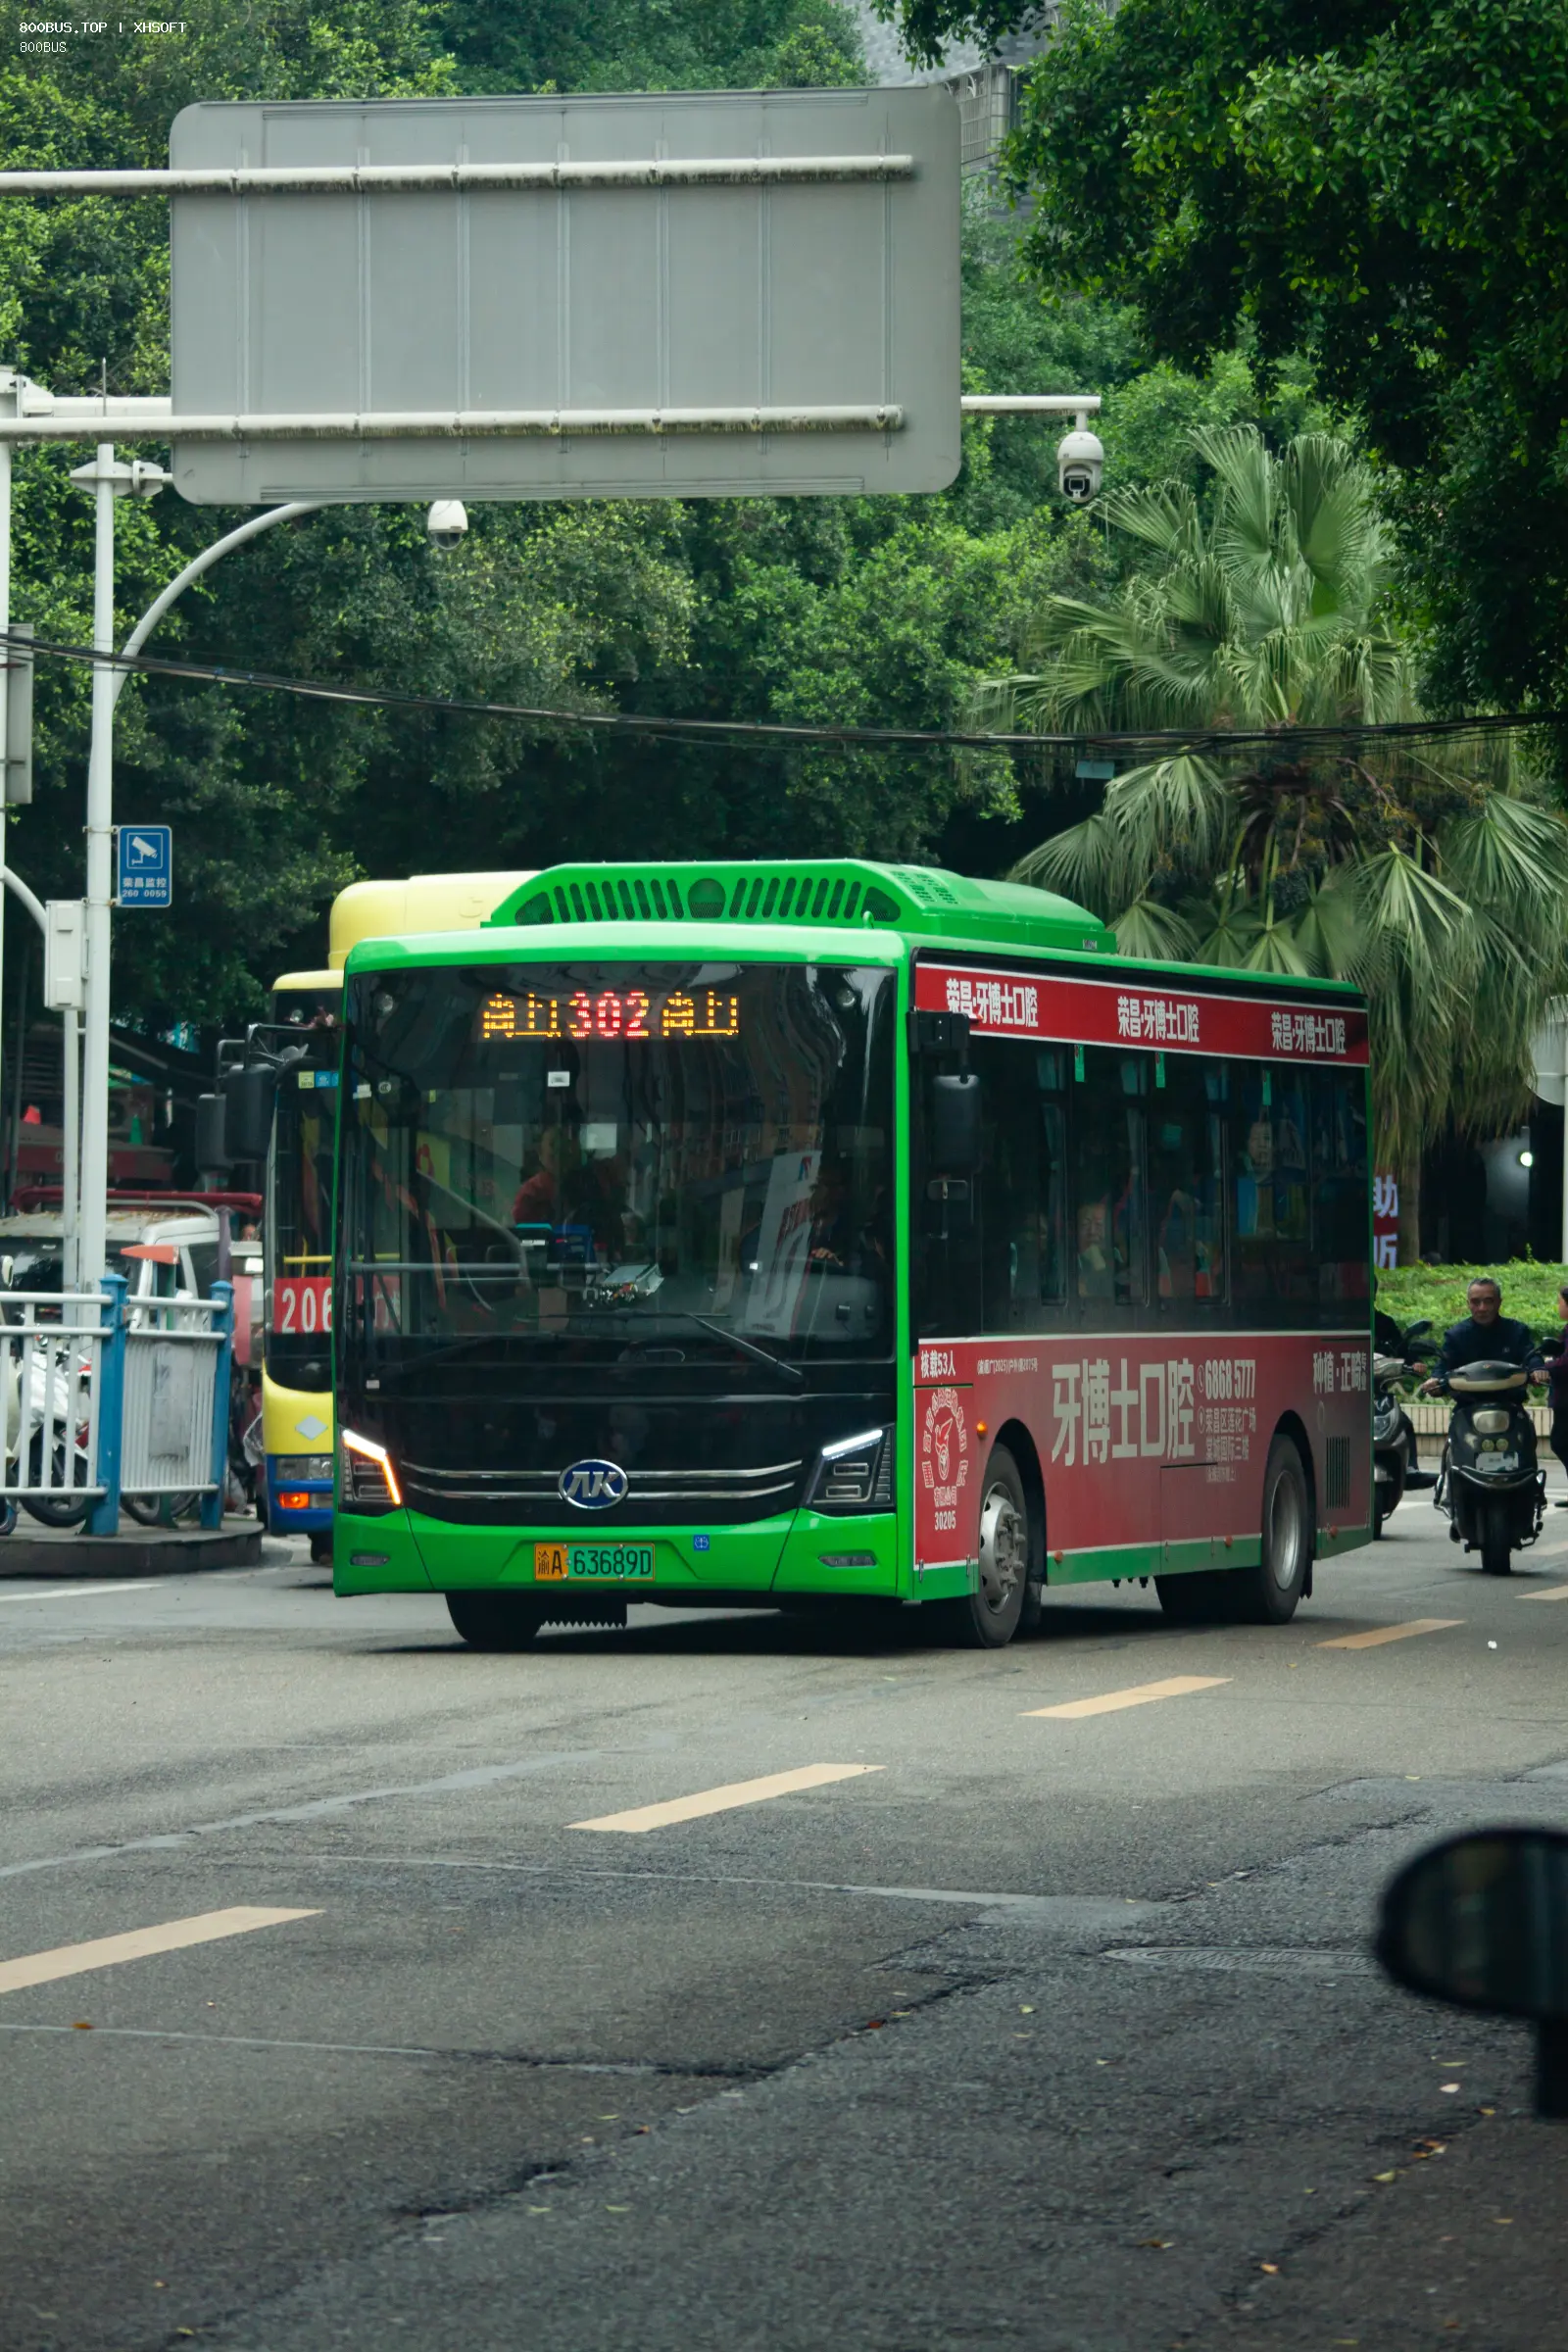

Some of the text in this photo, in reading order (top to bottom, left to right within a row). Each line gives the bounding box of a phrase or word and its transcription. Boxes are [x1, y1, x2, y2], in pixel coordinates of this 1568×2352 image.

[122, 877, 168, 888] 荣昌监控
[568, 992, 650, 1037] 302
[920, 1349, 956, 1378] 核载53人
[1205, 1358, 1256, 1399] 6868 5777
[1052, 1357, 1195, 1467] 牙博士口腔
[1205, 1406, 1256, 1434] 荣昌区莲花广场
[934, 1509, 956, 1532] 30205
